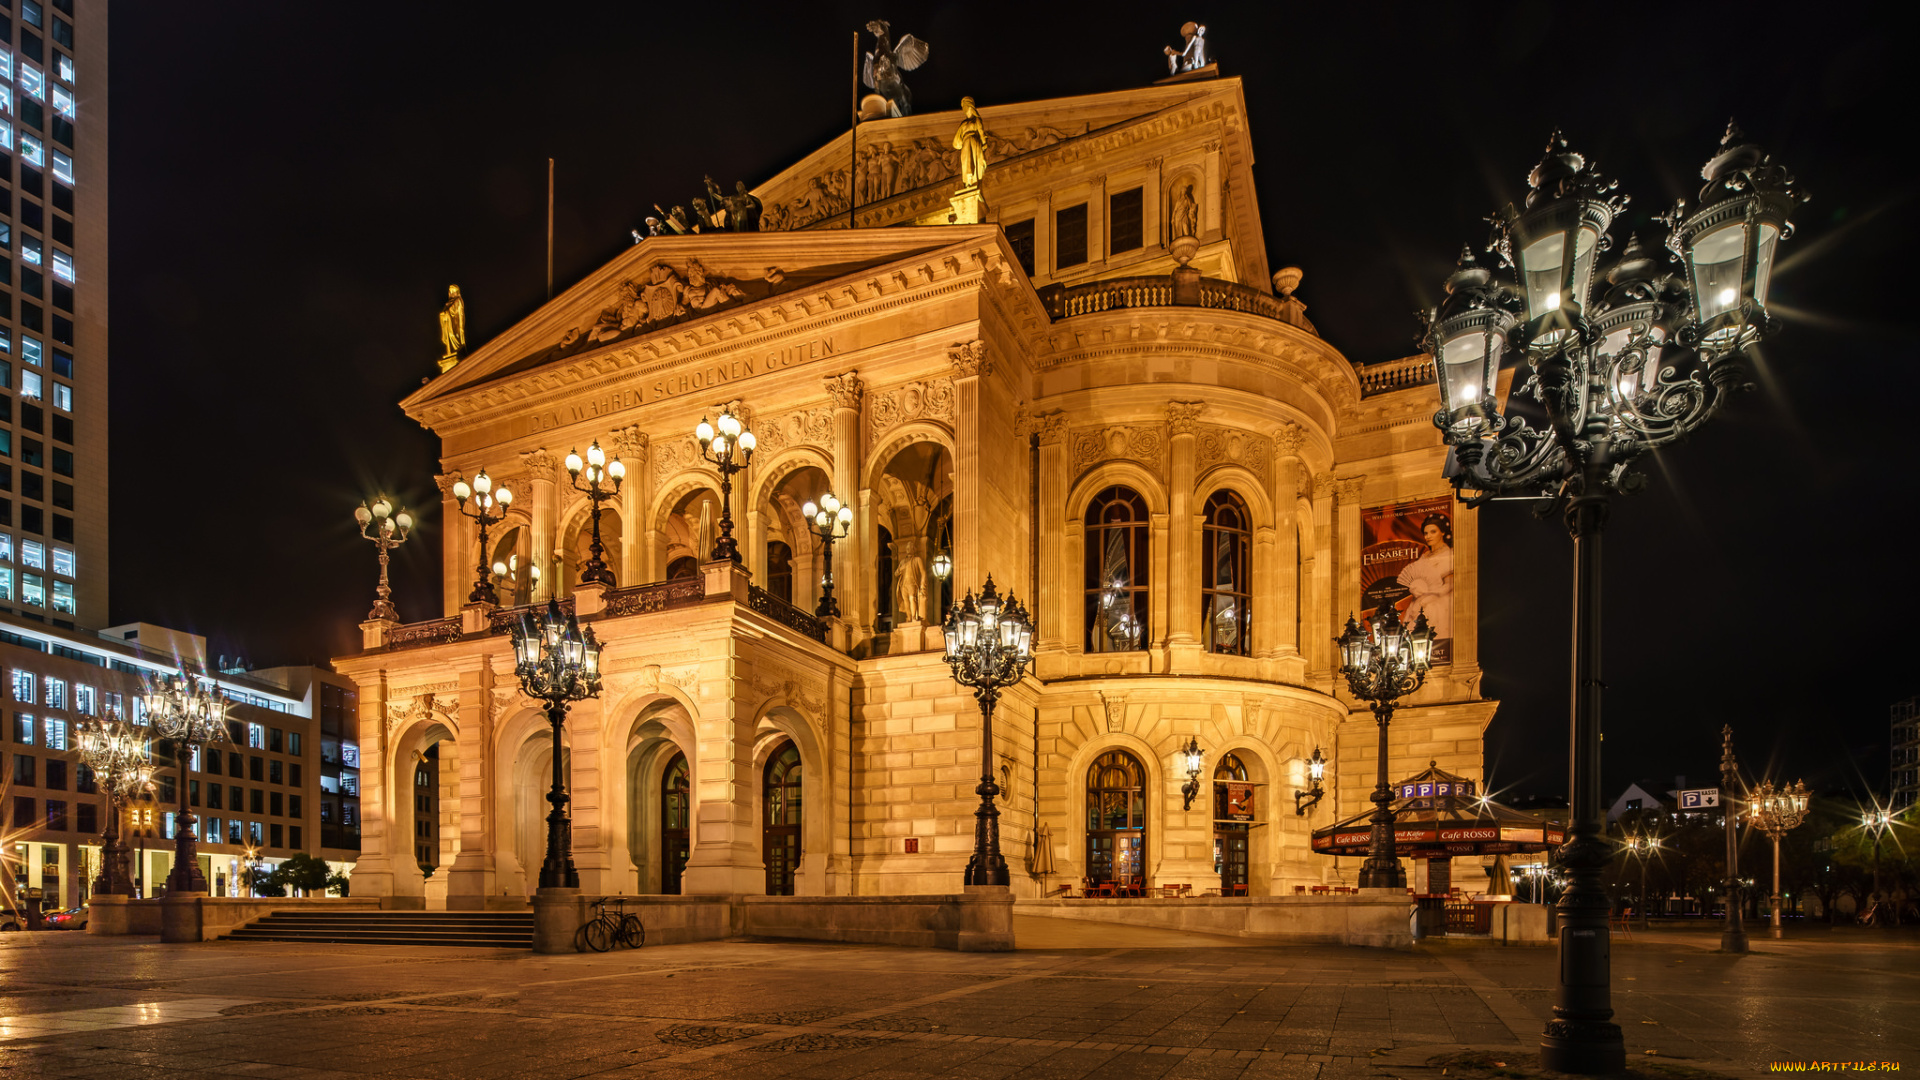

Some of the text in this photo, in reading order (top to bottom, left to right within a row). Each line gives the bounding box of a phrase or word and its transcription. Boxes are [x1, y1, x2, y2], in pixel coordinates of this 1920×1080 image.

[531, 410, 563, 432] DEM
[571, 388, 643, 420] WAHREN
[654, 357, 754, 399] SCHOENEN
[1364, 547, 1419, 566] ELISABETH
[1421, 786, 1430, 796] P
[1439, 786, 1448, 796] P
[1336, 836, 1350, 844] Café
[1351, 834, 1370, 843] ROSS
[1463, 831, 1495, 839] ROSSO
